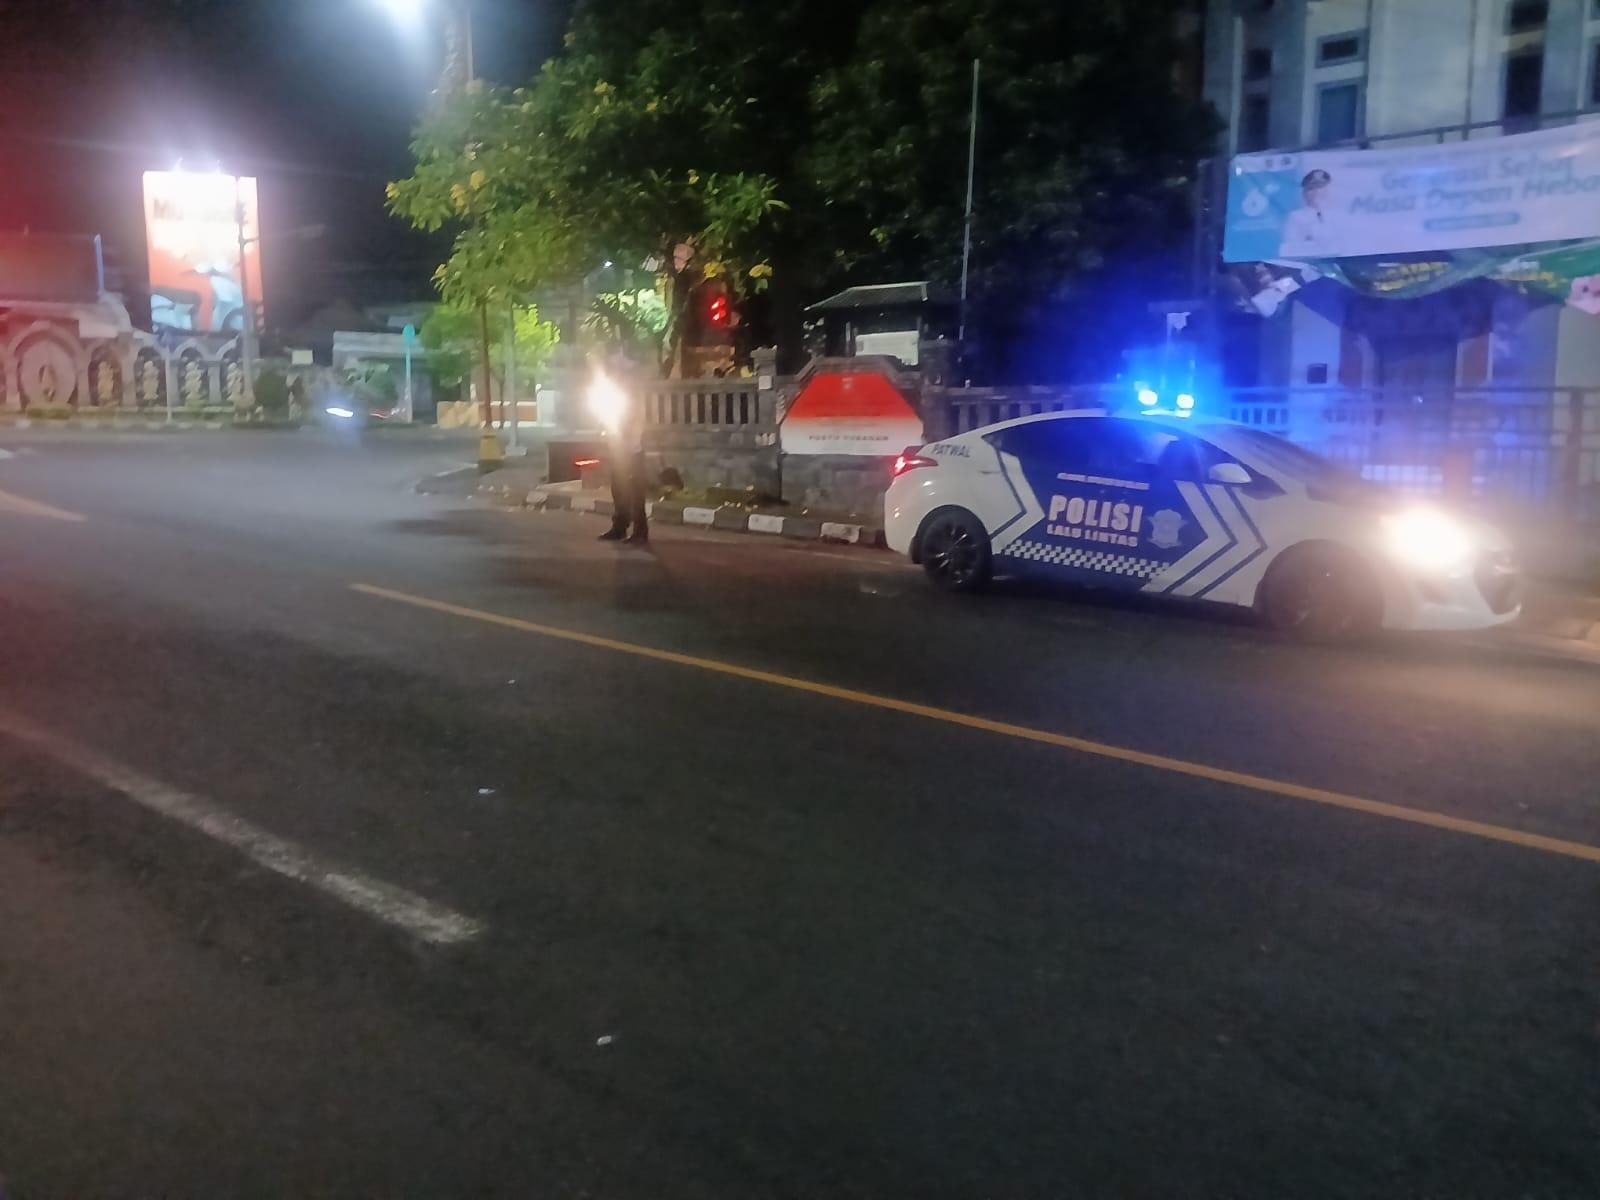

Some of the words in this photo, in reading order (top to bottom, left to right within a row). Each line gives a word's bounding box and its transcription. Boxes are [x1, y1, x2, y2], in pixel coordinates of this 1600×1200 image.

[931, 443, 971, 458] PATWAL
[1048, 494, 1143, 533] POLISI
[1046, 524, 1082, 539] LALU
[1084, 529, 1138, 547] LINTAS
